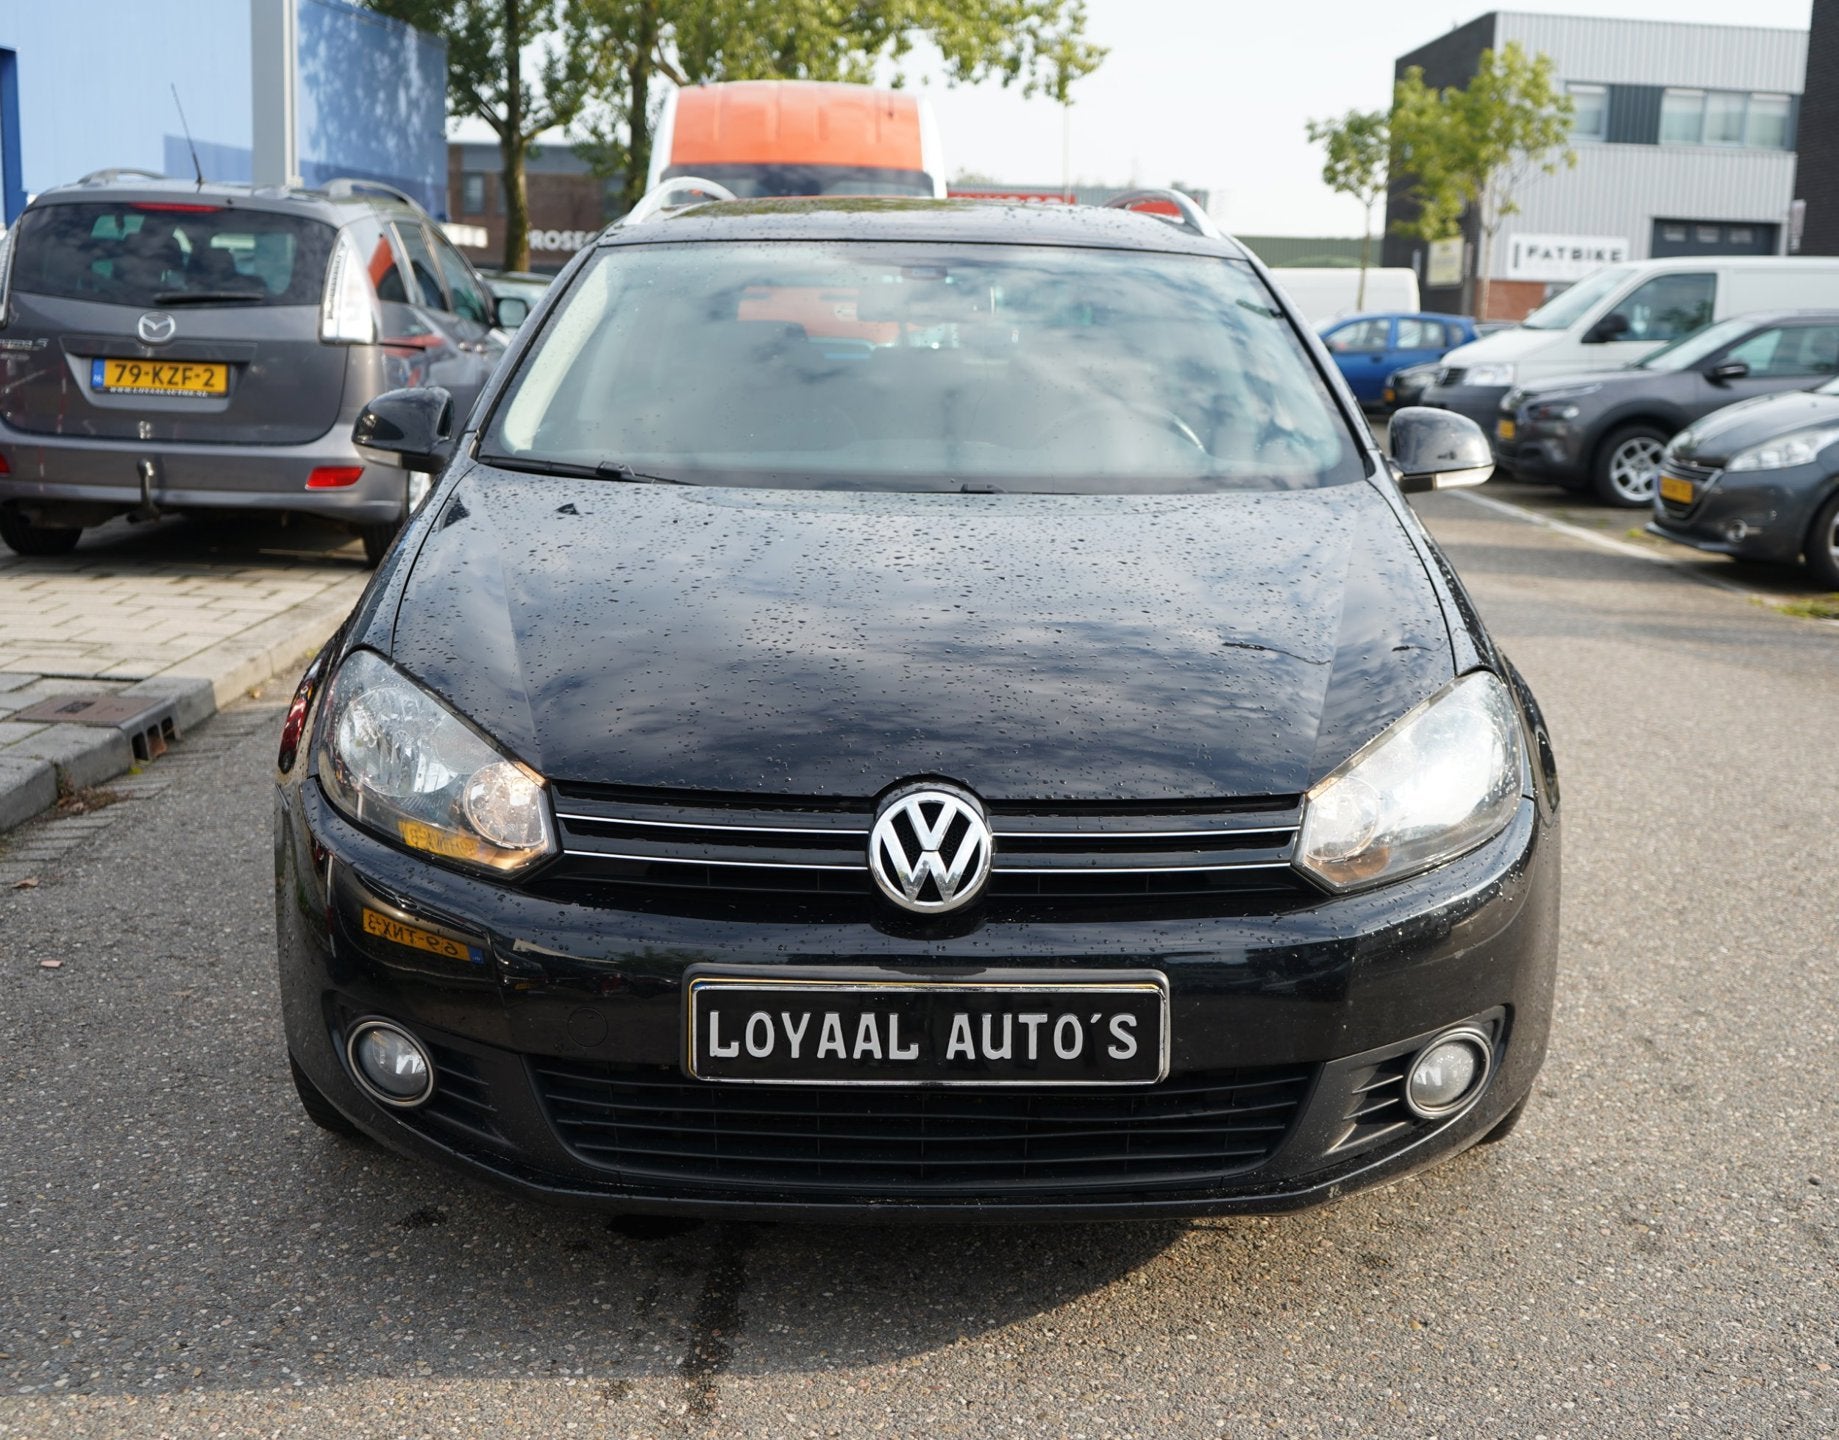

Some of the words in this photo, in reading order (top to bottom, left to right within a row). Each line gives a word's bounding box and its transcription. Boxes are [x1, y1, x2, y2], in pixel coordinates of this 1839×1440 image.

[1527, 245, 1621, 261] FATBIKE
[114, 363, 215, 387] 79-KZF-2
[709, 1011, 919, 1059] LOYAAL
